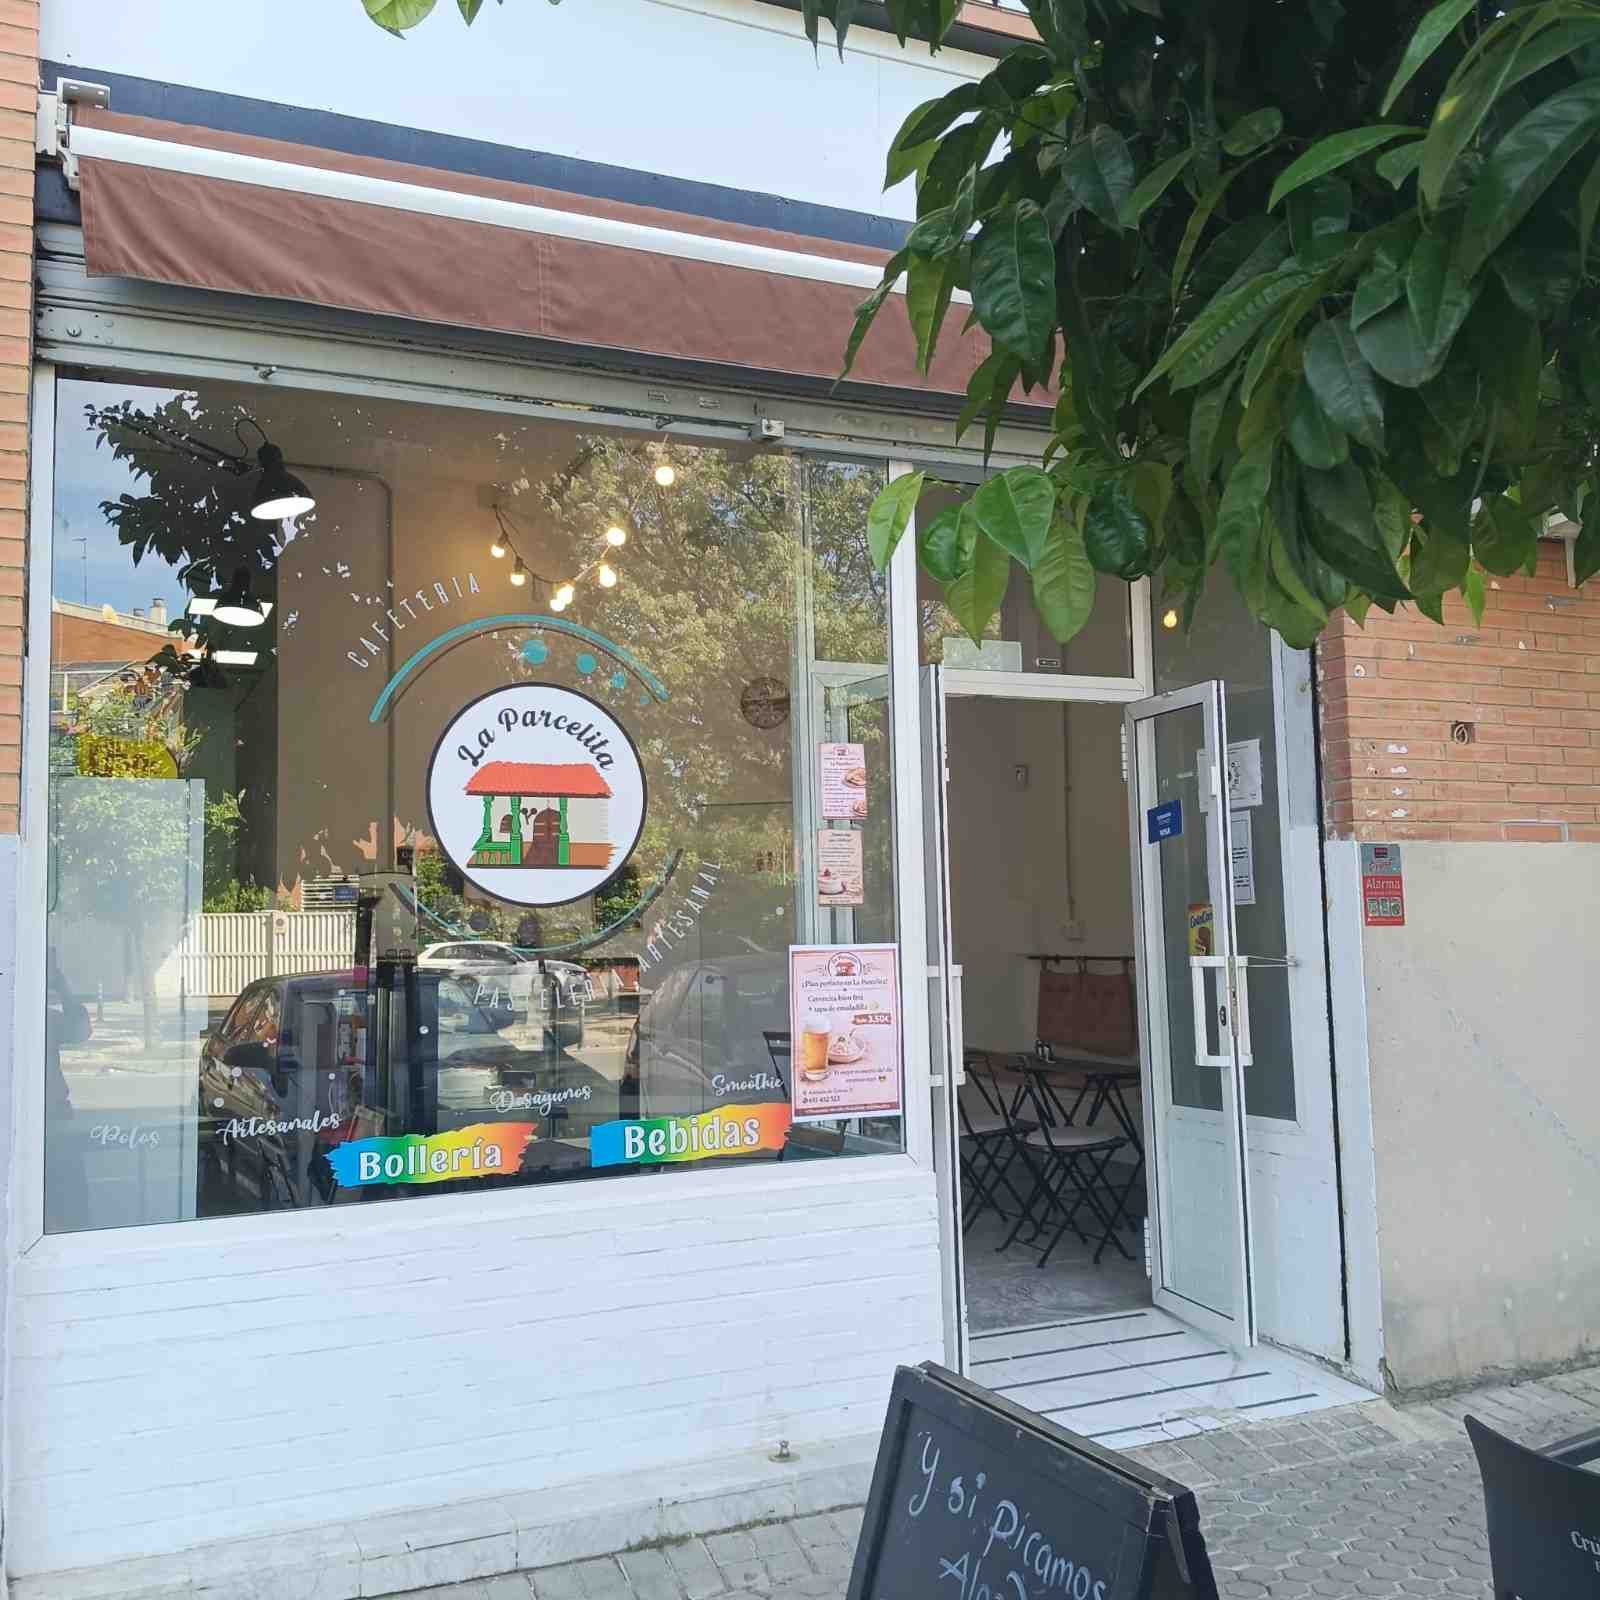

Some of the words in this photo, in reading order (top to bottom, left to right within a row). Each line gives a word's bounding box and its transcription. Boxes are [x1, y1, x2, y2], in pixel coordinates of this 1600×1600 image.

[345, 572, 481, 669] CAFETERIA
[457, 727, 496, 768] La
[497, 706, 616, 771] Parcelita
[637, 858, 722, 974] ARTESANAL
[489, 1084, 593, 1116] Desayunos
[90, 1123, 161, 1150] Polos
[215, 1109, 343, 1146] Artesanales
[624, 1114, 761, 1160] Bebidas
[357, 1137, 503, 1182] Bollería
